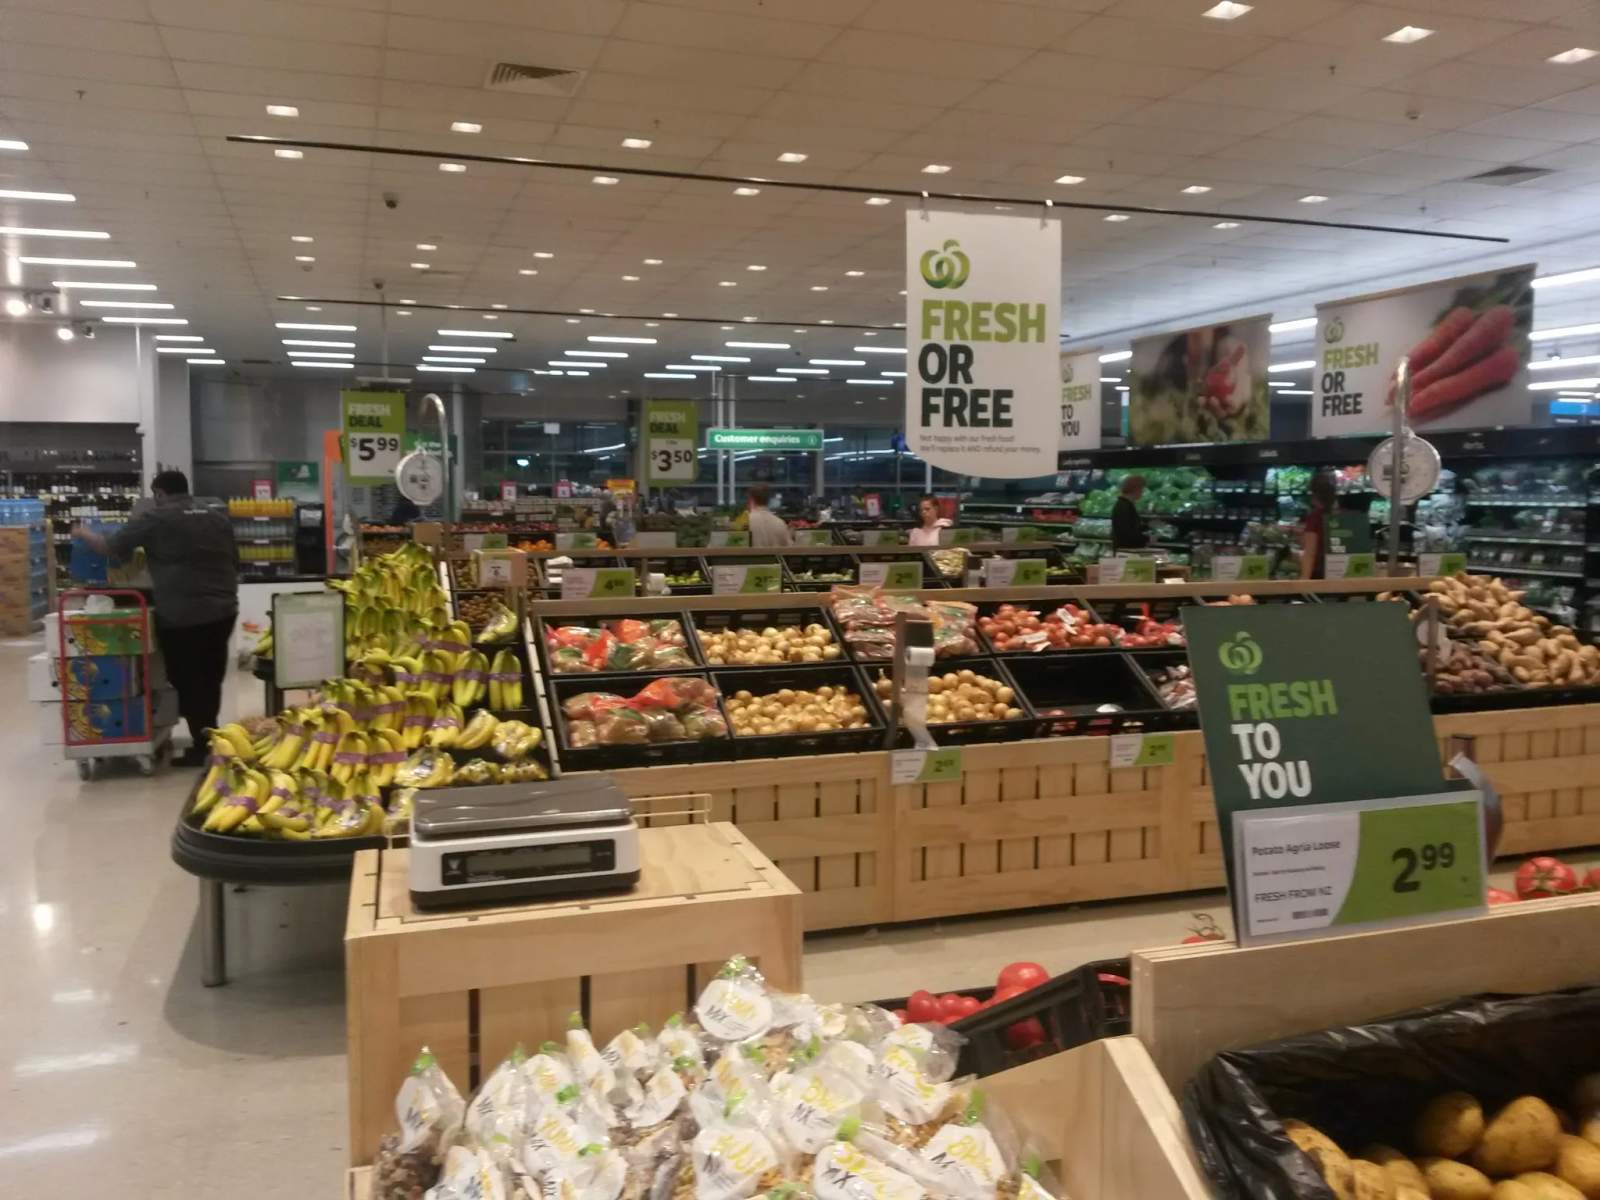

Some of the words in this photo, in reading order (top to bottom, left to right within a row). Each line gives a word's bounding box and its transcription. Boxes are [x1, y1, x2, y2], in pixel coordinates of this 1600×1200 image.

[921, 299, 1046, 343] FRESH
[918, 343, 974, 384] OR
[1323, 342, 1379, 371] FRESH
[1321, 371, 1345, 393] OR
[1062, 385, 1092, 402] FRESH
[349, 403, 391, 416] FRESH
[921, 387, 1014, 428] FREE
[1061, 404, 1074, 420] TO
[1322, 393, 1363, 417] FREE
[349, 415, 383, 428] DEAL
[649, 411, 686, 423] FRESH
[650, 422, 679, 434] DEAL
[1061, 421, 1080, 436] YOU
[714, 434, 758, 444] Customer
[759, 434, 800, 446] enquiries
[1228, 680, 1338, 720] FRESH
[1231, 722, 1281, 760] TO
[1238, 760, 1312, 800] YOU
[1252, 846, 1284, 856] Potato
[1286, 843, 1312, 855] Agria
[1313, 841, 1341, 851] Loose
[1255, 891, 1286, 903] FRESH
[1288, 887, 1316, 899] FROM
[1318, 886, 1333, 896] NZ
